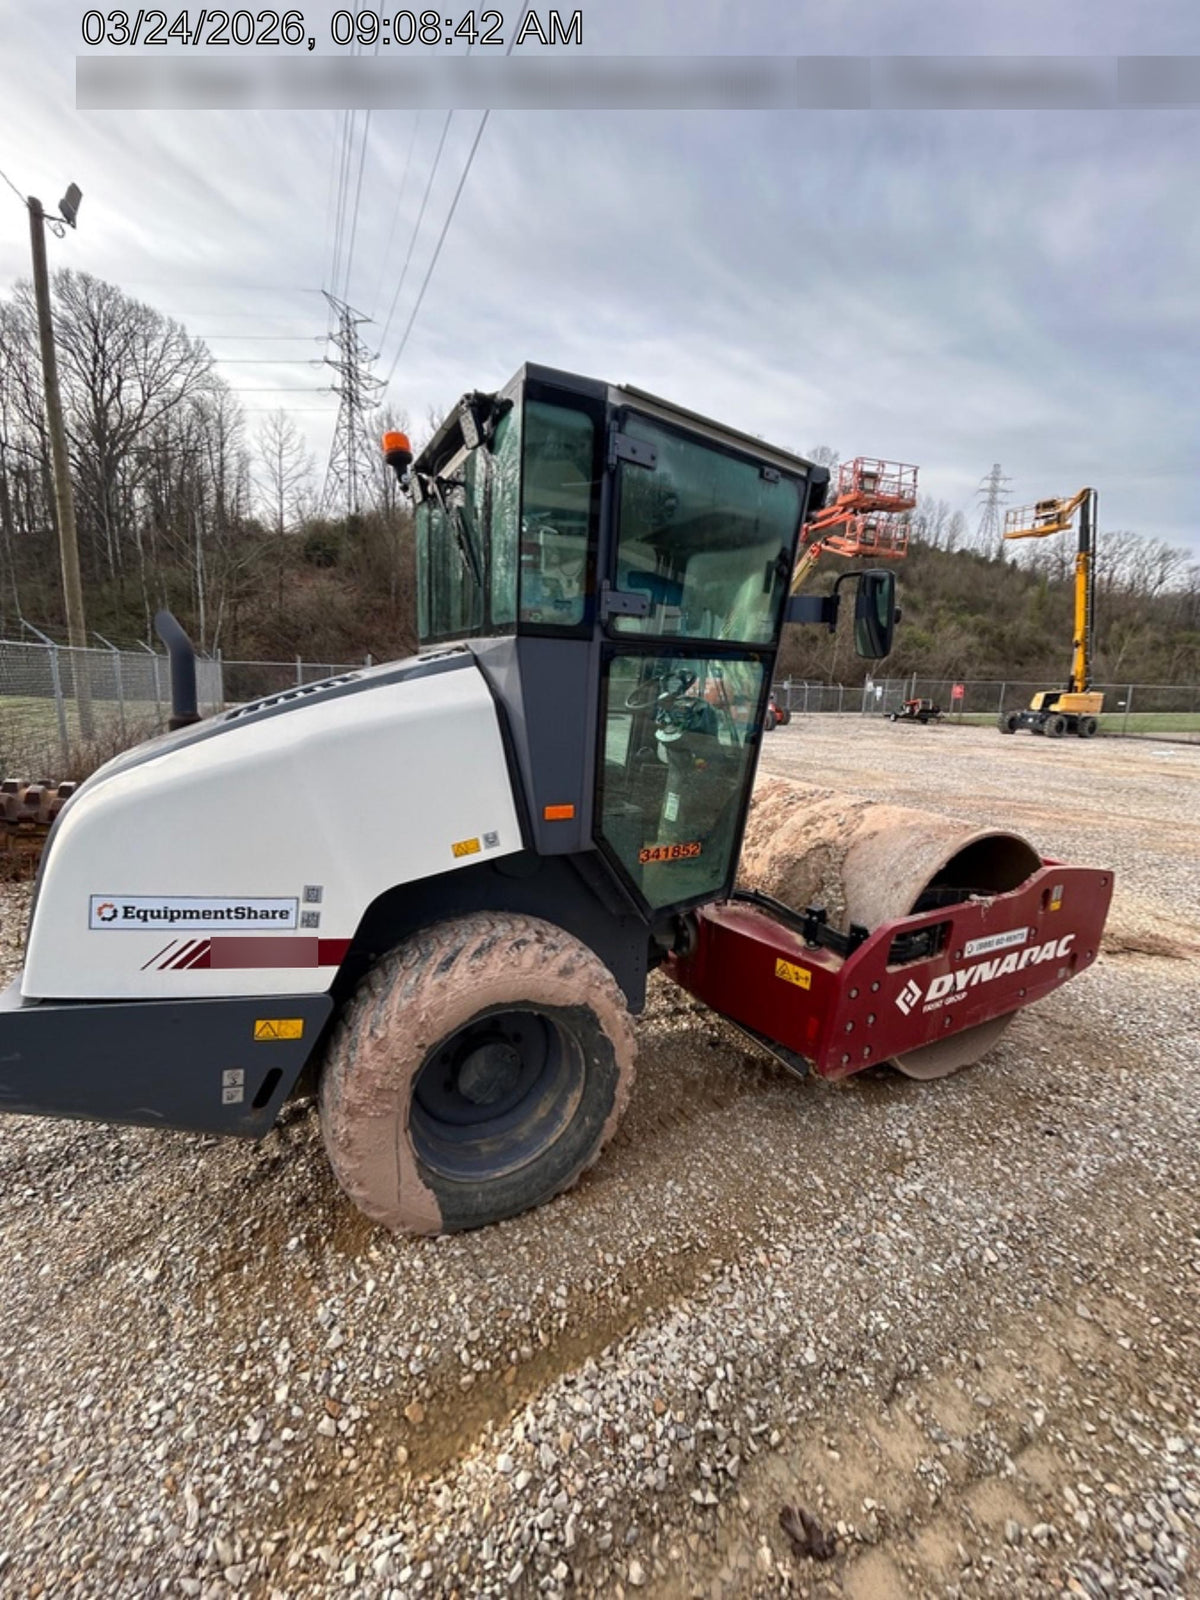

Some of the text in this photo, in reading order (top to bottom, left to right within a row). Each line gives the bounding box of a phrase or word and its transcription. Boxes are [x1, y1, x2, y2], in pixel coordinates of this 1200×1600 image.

[640, 842, 700, 863] 341852
[122, 905, 290, 923] EquipmentShare
[925, 934, 1076, 1002] DYNAPAC
